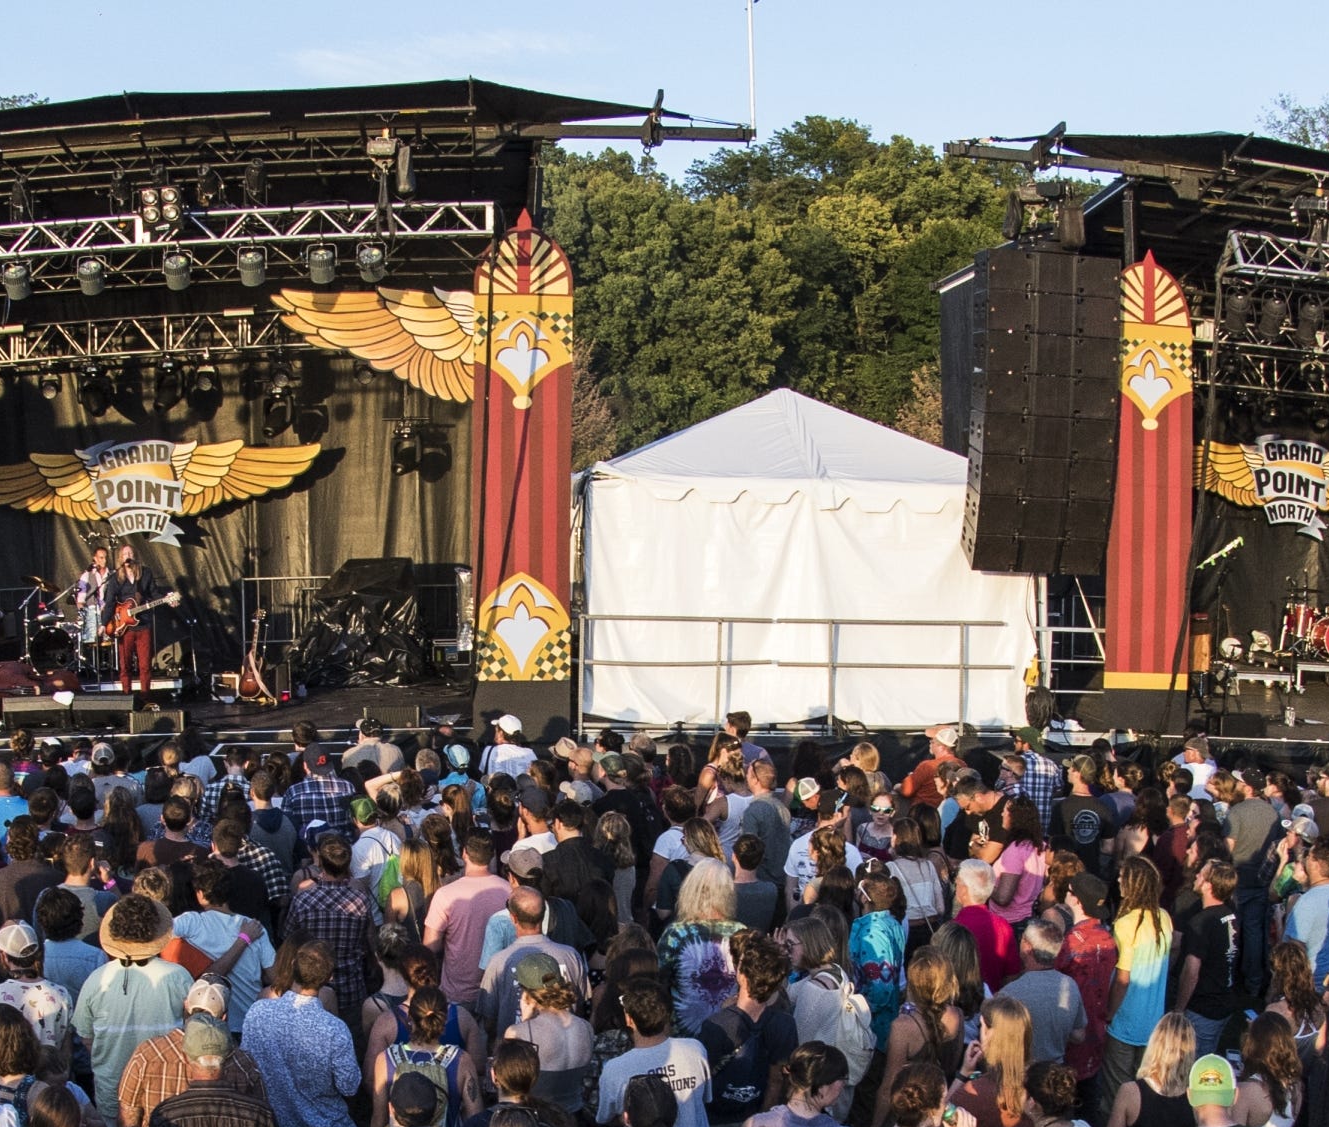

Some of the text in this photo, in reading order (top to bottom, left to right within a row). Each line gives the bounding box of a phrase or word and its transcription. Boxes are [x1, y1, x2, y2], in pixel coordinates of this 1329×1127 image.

[99, 443, 170, 472] GRAND
[1264, 442, 1323, 466] GRAND
[96, 479, 181, 510] POINT
[1255, 468, 1326, 504] POINT
[111, 513, 169, 533] NORTH
[1266, 503, 1316, 524] NORTH
